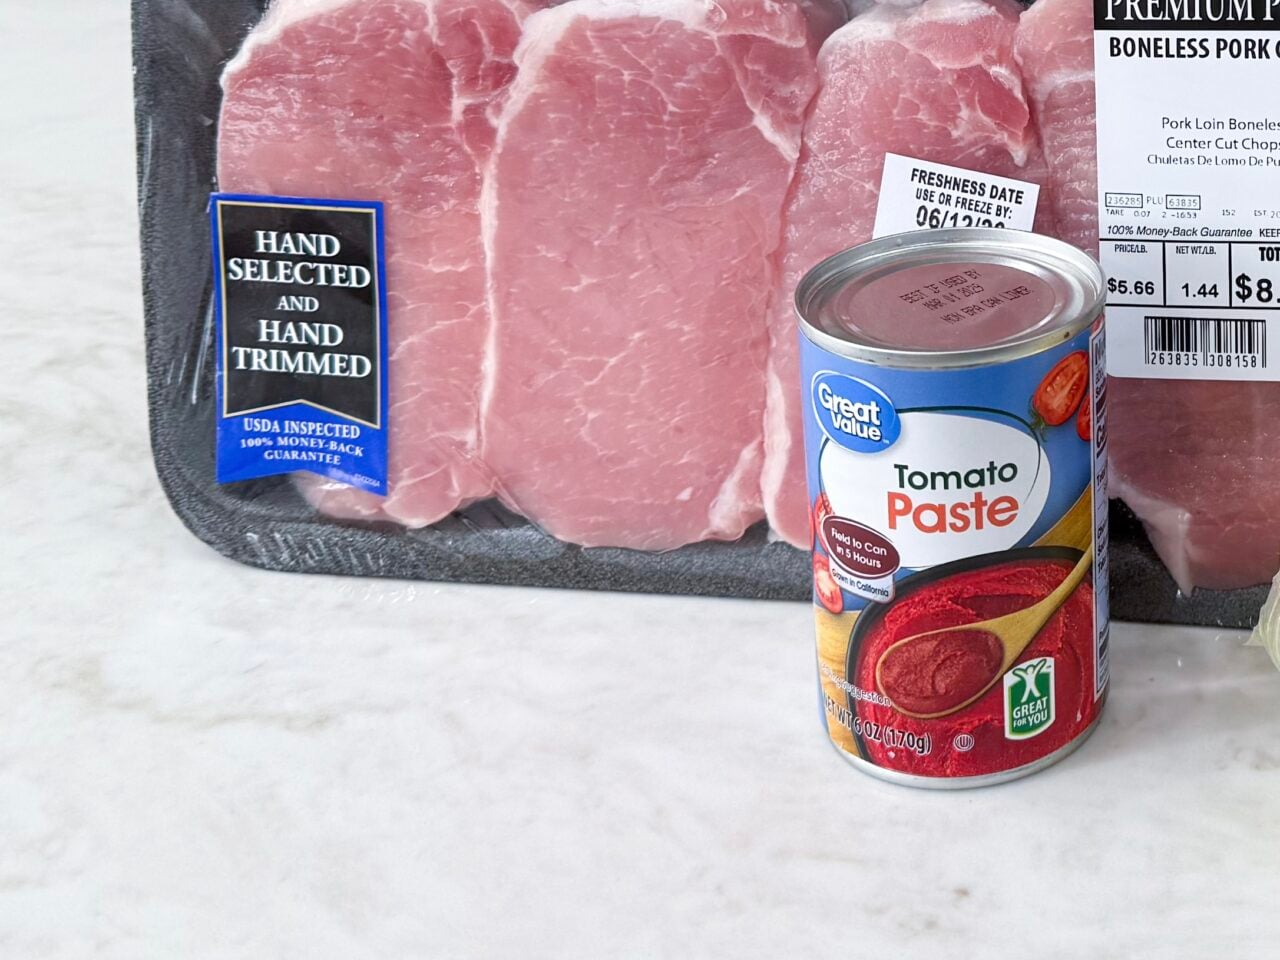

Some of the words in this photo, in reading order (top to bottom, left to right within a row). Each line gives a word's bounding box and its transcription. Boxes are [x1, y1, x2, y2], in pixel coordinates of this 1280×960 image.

[1109, 37, 1210, 59] BONELESS
[1216, 38, 1270, 59] PORK
[1162, 117, 1192, 130] Pork
[1195, 118, 1225, 131] Loin
[1166, 137, 1212, 150] Center
[1215, 138, 1240, 150] Cut
[1147, 154, 1195, 166] Chuletas
[1197, 155, 1213, 166] De
[1215, 155, 1246, 166] Lomo
[1249, 156, 1264, 167] De
[910, 167, 986, 197] FRESHNESS
[989, 184, 1024, 205] DATE
[915, 188, 935, 203] USE
[938, 192, 952, 206] OR
[955, 196, 992, 215] FREEZE
[995, 204, 1013, 220] BY:
[1146, 196, 1164, 205] PLU
[1106, 208, 1124, 216] TARE
[1107, 225, 1134, 235] 100%
[1136, 225, 1198, 238] Money-Back
[1200, 227, 1253, 238] Guarantee
[255, 230, 341, 257] HAND
[1114, 243, 1148, 255] PRICE/LB.
[1175, 245, 1189, 255] NET
[228, 257, 371, 288] SELECTED
[1107, 277, 1155, 296] $5.66
[1181, 283, 1219, 298] 1.44
[275, 295, 320, 313] AND
[258, 319, 344, 346] HAND
[232, 346, 372, 378] TRIMMED
[1150, 352, 1198, 367] 263835
[1209, 354, 1257, 369] 308158
[818, 382, 881, 426] Great
[243, 417, 280, 433] USDA
[284, 420, 361, 439] INSPECTED
[830, 410, 882, 442] Value
[240, 438, 274, 449] 100%
[277, 436, 364, 457] MONEY-BACK
[264, 449, 342, 465] GUARANTEE
[894, 461, 1018, 490] Tomato
[887, 491, 1019, 534] Paste
[831, 527, 851, 546] Field
[852, 538, 863, 550] to
[864, 542, 887, 556] Can
[836, 543, 844, 556] in
[845, 548, 852, 559] 5
[853, 551, 882, 569] Hours
[1013, 696, 1048, 719] GREAT
[1013, 717, 1026, 728] FOR
[1027, 709, 1048, 727] YOU
[854, 717, 863, 734] 6
[864, 721, 881, 742] OZ
[883, 726, 932, 755] (170g)
